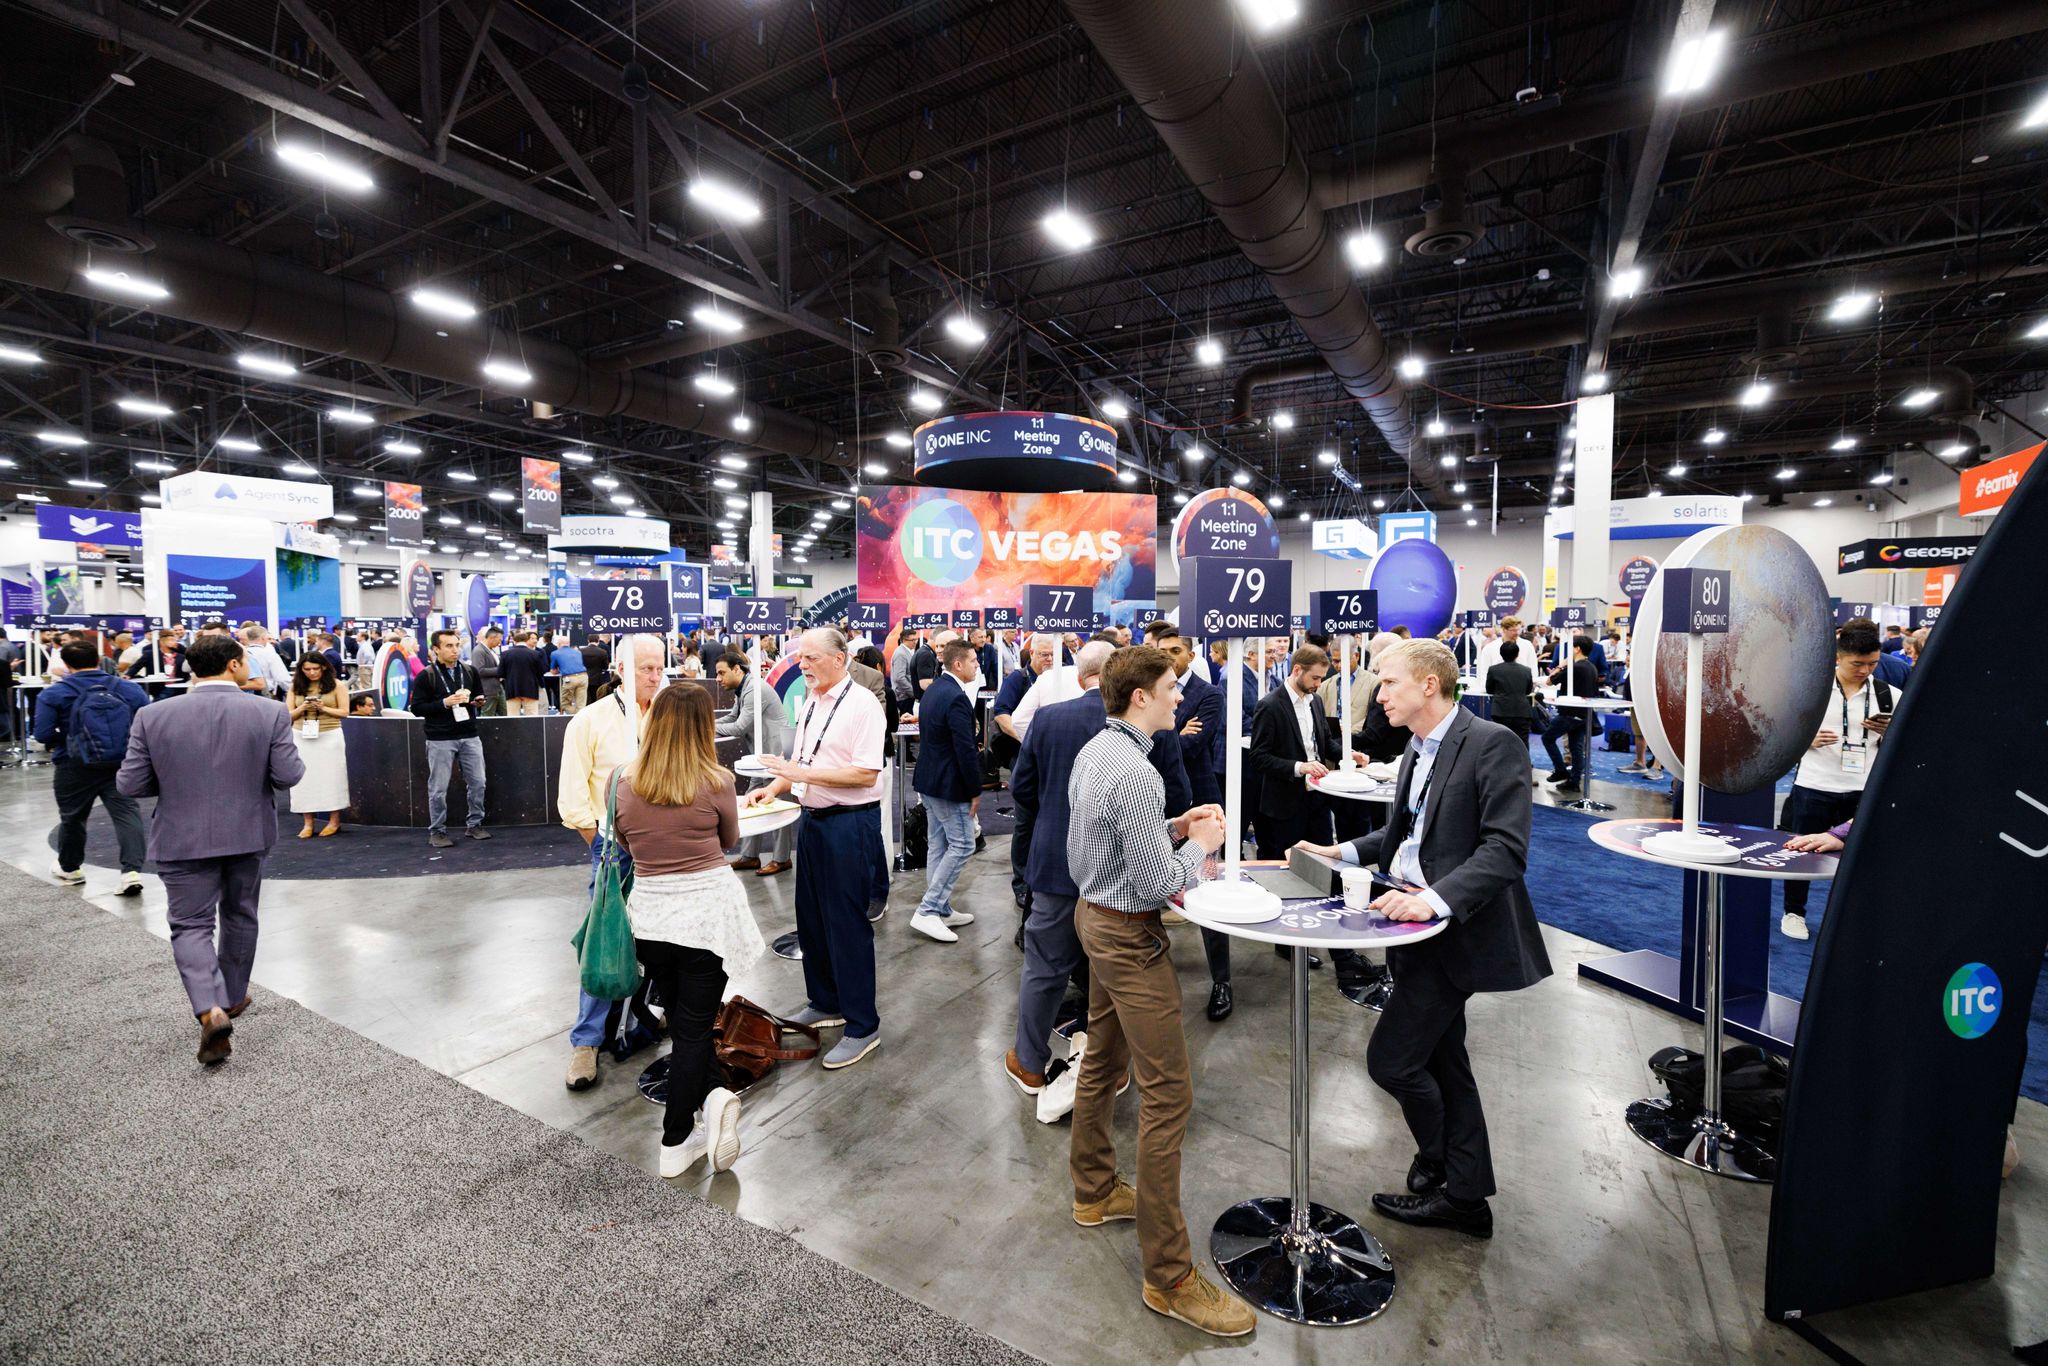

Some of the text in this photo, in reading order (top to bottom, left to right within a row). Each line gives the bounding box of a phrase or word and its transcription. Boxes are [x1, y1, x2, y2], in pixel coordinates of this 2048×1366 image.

[1031, 418, 1044, 429] 1:1
[938, 429, 991, 448] ONE INC
[1014, 430, 1060, 445] Meeting
[1022, 443, 1053, 455] Zone
[1094, 437, 1111, 455] ONE
[244, 488, 319, 505] AgentSync
[527, 487, 557, 503] 2100
[388, 507, 421, 521] 2000
[1221, 502, 1237, 516] 1:1
[1673, 502, 1728, 518] solartis
[569, 527, 615, 536] socotra
[1200, 518, 1257, 537] Meeting
[913, 527, 1122, 562] ITC VEGAS
[1210, 536, 1247, 550] Zone
[180, 583, 228, 591] Transform
[1225, 567, 1266, 604] 79
[1493, 580, 1517, 588] Meeting
[180, 591, 237, 599] Distribution
[673, 591, 700, 600] socotra
[1702, 576, 1721, 606] 80
[181, 599, 226, 607] Networks
[607, 586, 644, 611] 78
[1048, 591, 1076, 612] 77
[745, 601, 770, 619] 73
[1337, 595, 1362, 615] 76
[1854, 605, 1867, 617] 87
[861, 606, 876, 619] 71
[930, 614, 942, 623] 64
[959, 611, 973, 621] 65
[993, 609, 1008, 621] 68
[1144, 611, 1158, 621] 67
[1478, 611, 1487, 621] 91
[1568, 609, 1580, 619] 89
[1926, 607, 1941, 618] 88
[609, 616, 663, 628] ONE INC
[1048, 618, 1070, 628] ONE
[1071, 618, 1088, 628] INC
[1225, 614, 1284, 628] ONE INC
[1292, 616, 1302, 624] 95
[1338, 619, 1374, 630] ONE INC
[1703, 614, 1727, 626] ONE INC
[746, 623, 781, 631] ONE INC
[389, 675, 407, 697] ITC
[1951, 985, 1996, 1017] ITC
